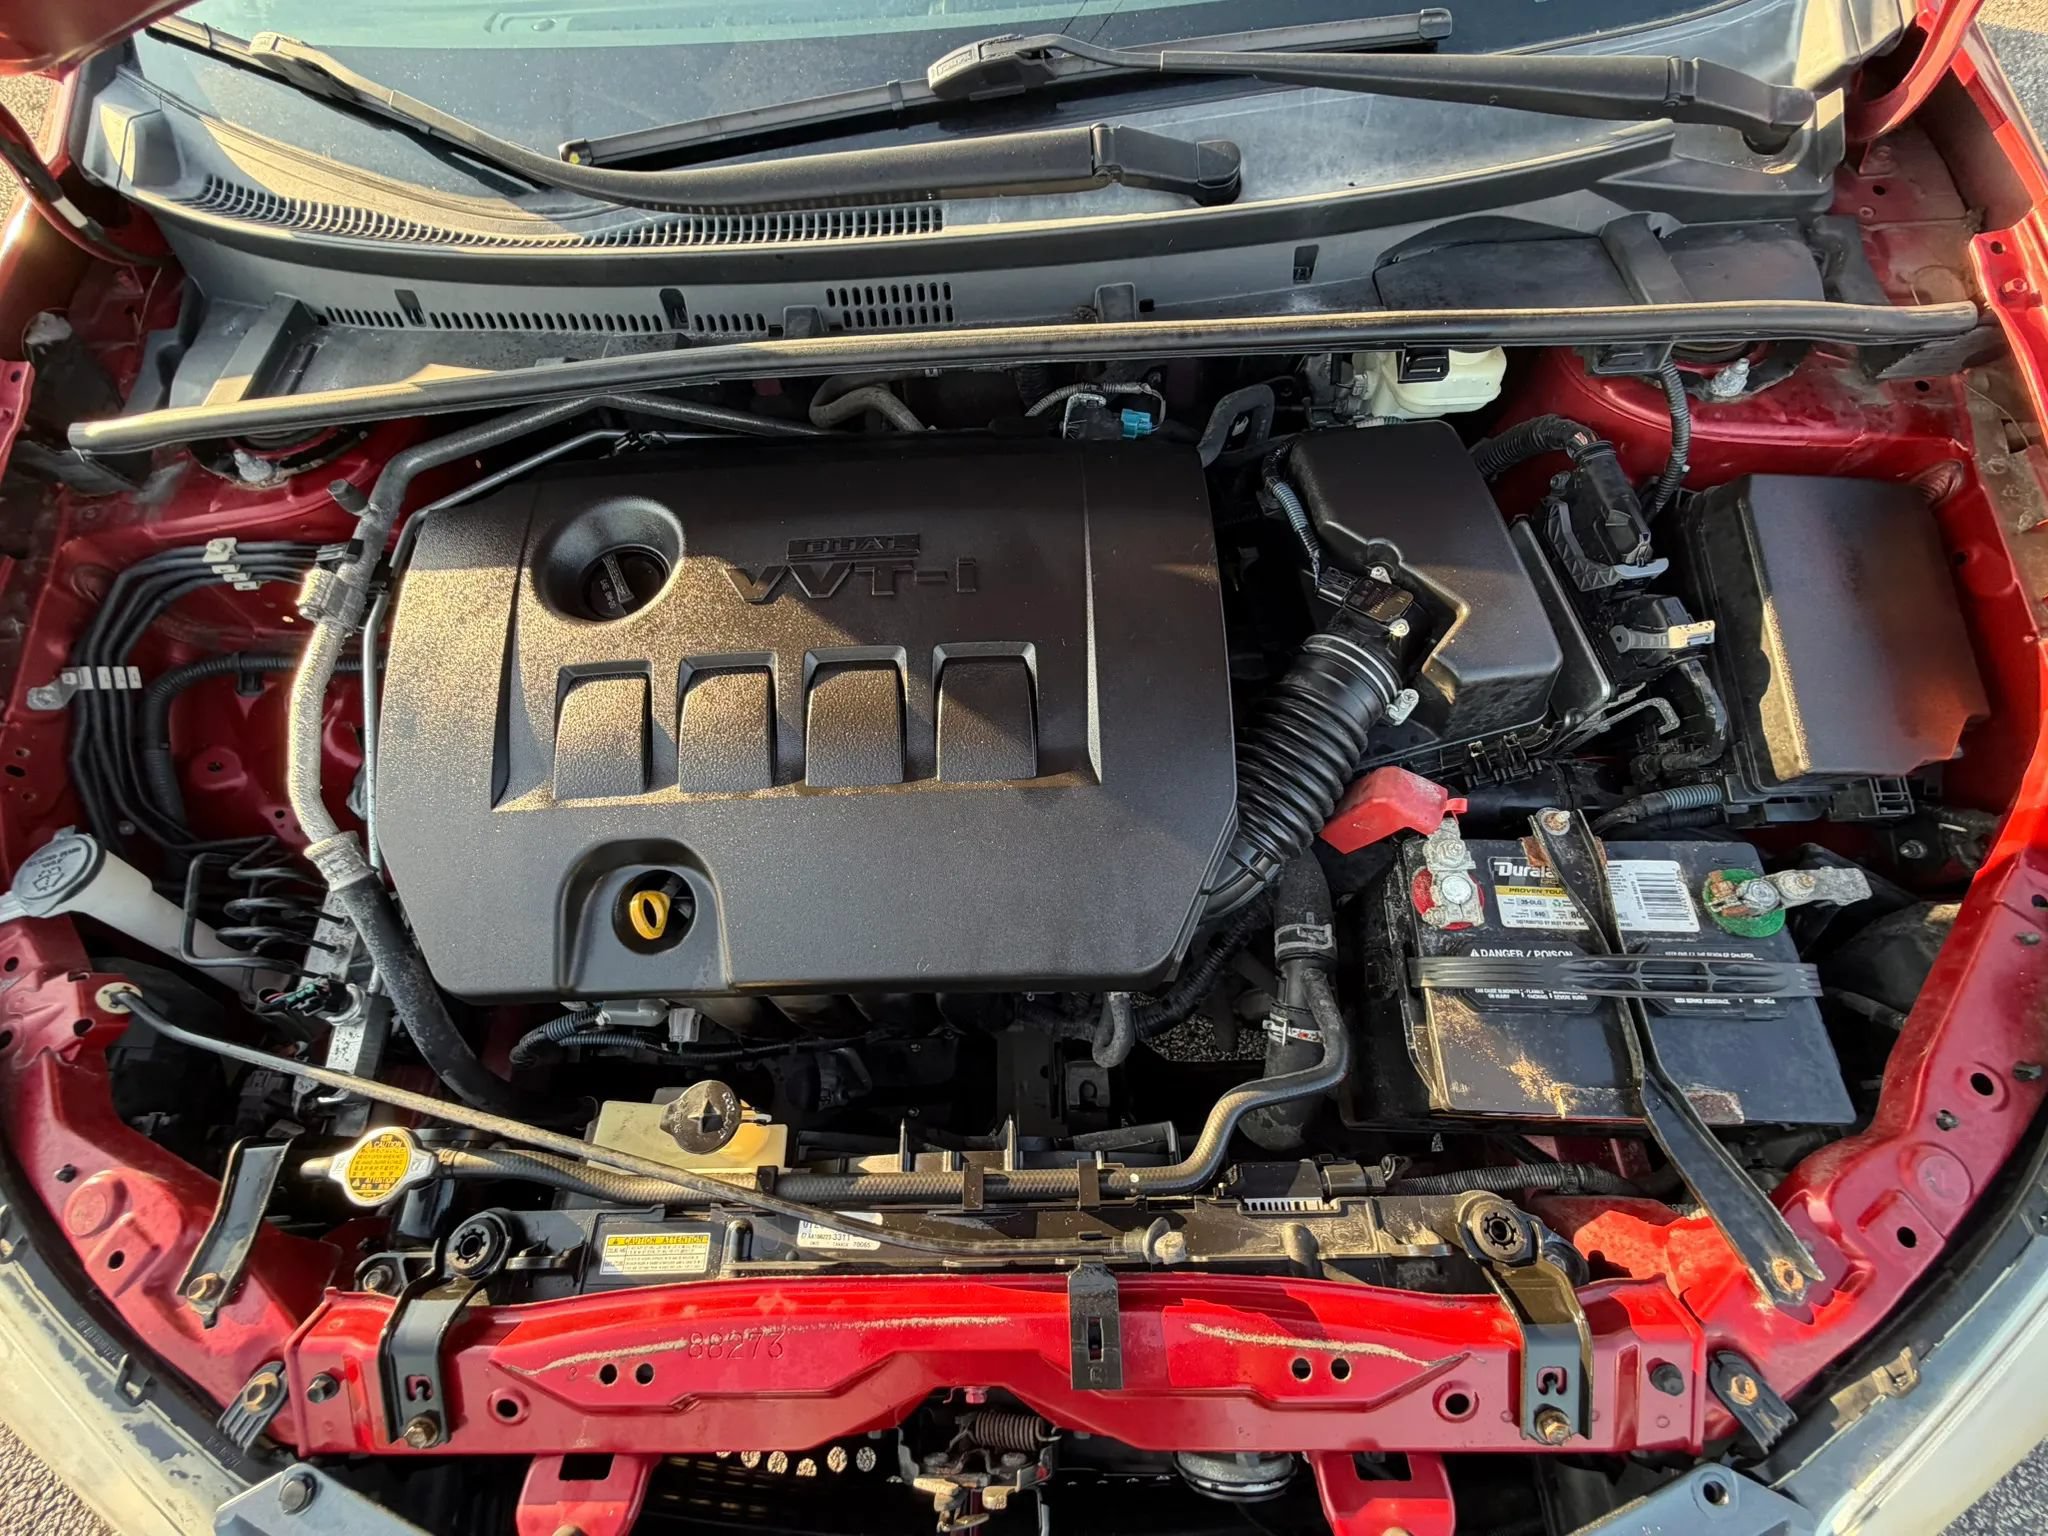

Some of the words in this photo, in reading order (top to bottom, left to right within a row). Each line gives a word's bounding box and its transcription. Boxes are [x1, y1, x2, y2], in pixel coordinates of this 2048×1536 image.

[804, 536, 911, 553] DUAL
[1493, 862, 1556, 878] Durala
[1508, 887, 1542, 895] PROVEN
[1479, 949, 1524, 958] DANGER
[624, 1237, 657, 1245] CAUTION
[663, 1235, 704, 1245] ATTENTION
[687, 1330, 786, 1360] 88273
